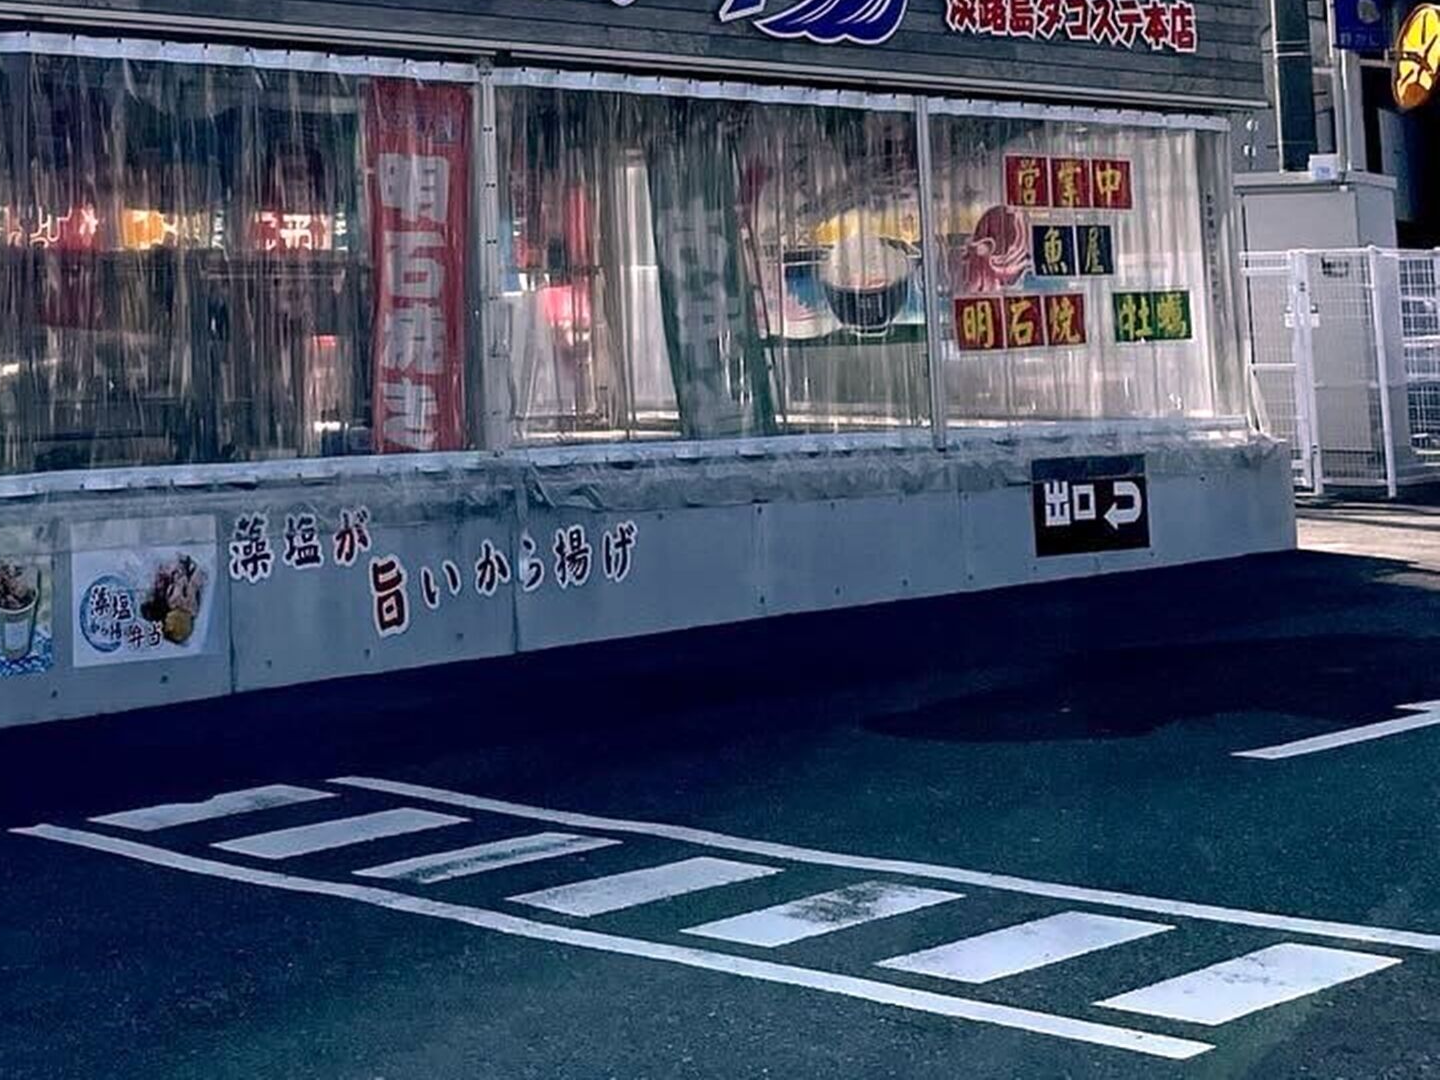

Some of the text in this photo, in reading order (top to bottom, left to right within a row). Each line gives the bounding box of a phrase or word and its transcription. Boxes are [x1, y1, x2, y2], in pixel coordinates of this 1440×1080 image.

[1017, 158, 1122, 206] 営業中
[962, 296, 1081, 349] 明石焼
[1044, 480, 1097, 527] 出口
[229, 505, 372, 583] 藻塩が
[370, 522, 638, 638] 旨いから揚げ
